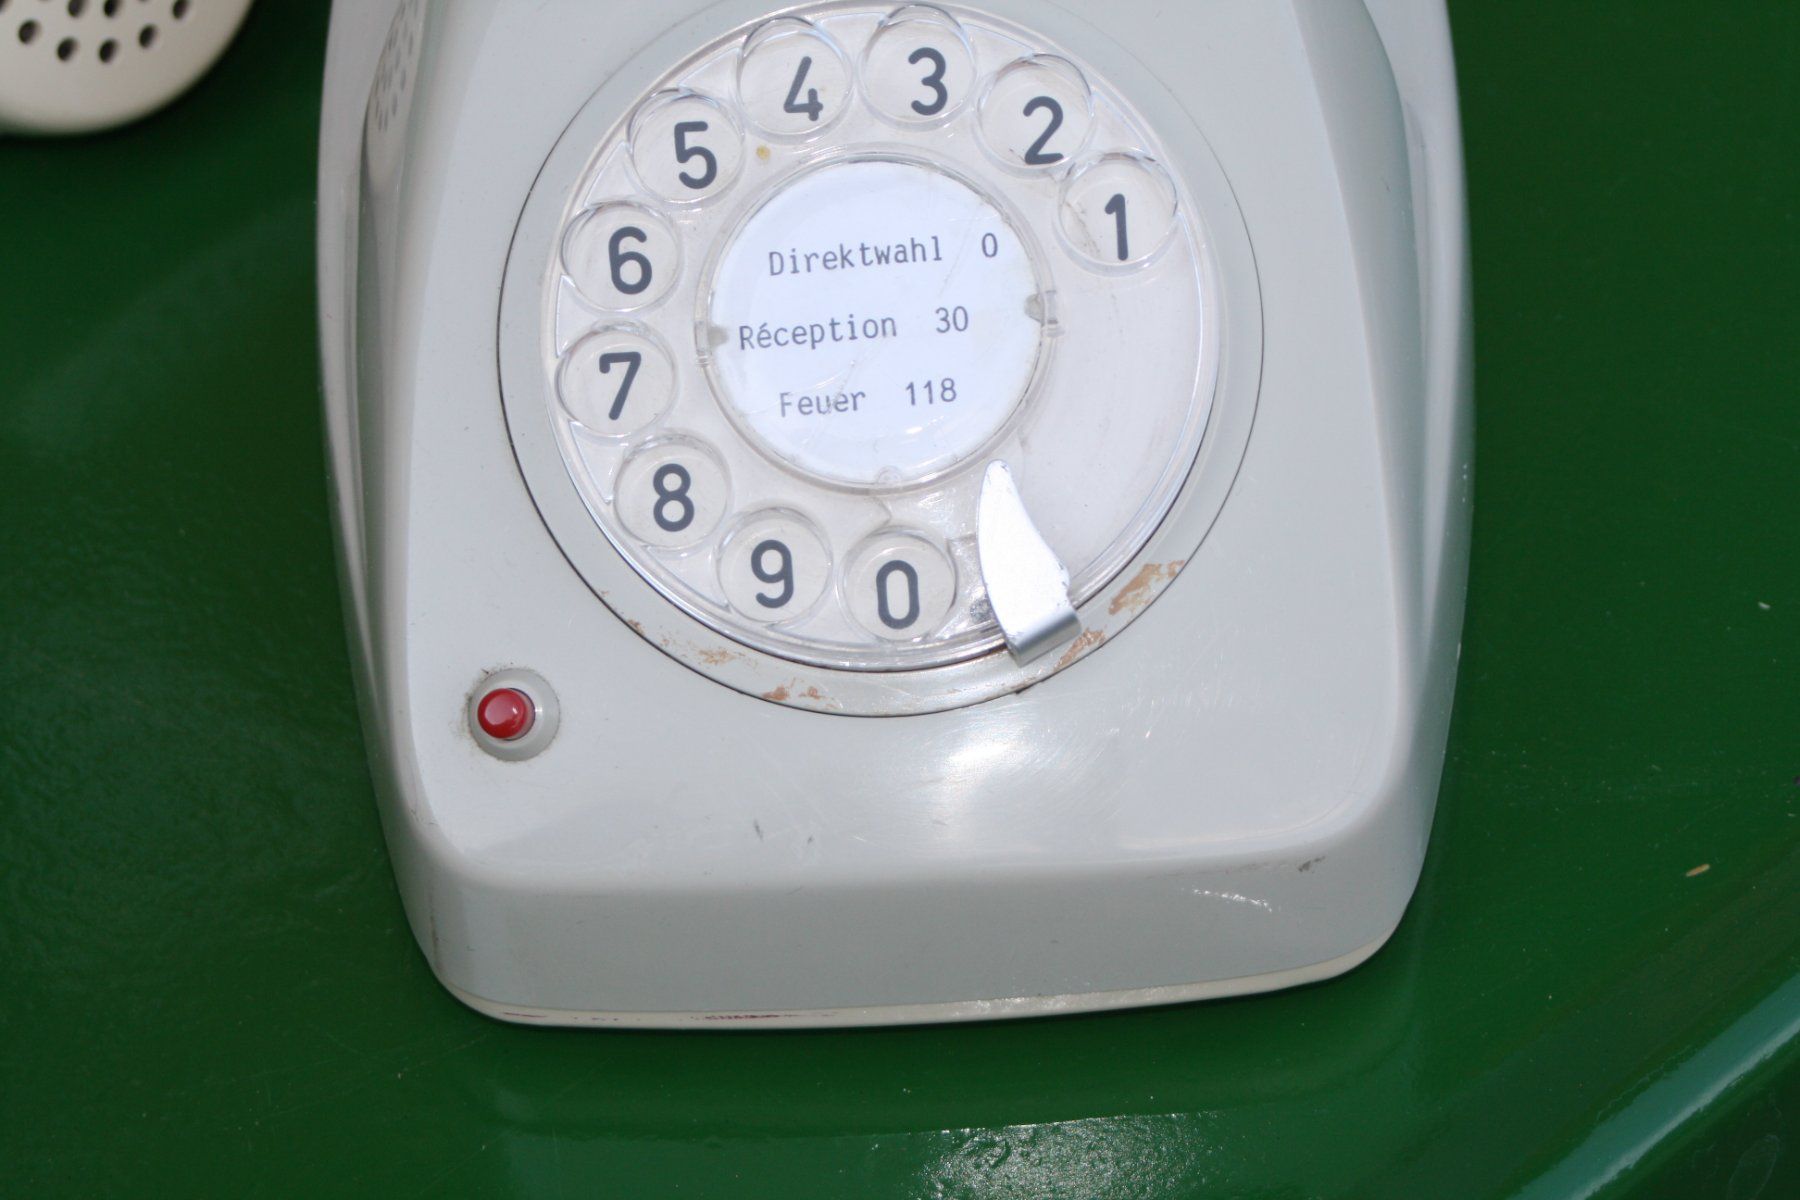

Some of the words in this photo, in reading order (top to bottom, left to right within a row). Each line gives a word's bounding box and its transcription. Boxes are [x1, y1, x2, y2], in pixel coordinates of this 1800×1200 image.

[784, 56, 824, 122] 4
[909, 48, 948, 116] 3
[674, 121, 718, 190] 5
[1022, 96, 1063, 165] 2
[608, 227, 653, 295] 6
[769, 236, 943, 276] Direktwahl
[981, 232, 999, 259] 0
[1105, 193, 1129, 262] 1
[738, 314, 897, 350] Réception
[935, 306, 969, 334] 30
[598, 352, 642, 421] 7
[780, 391, 867, 418] Feuer
[905, 378, 958, 407] 118
[653, 463, 695, 533] 8
[751, 539, 794, 608] 9
[876, 560, 920, 629] 0
